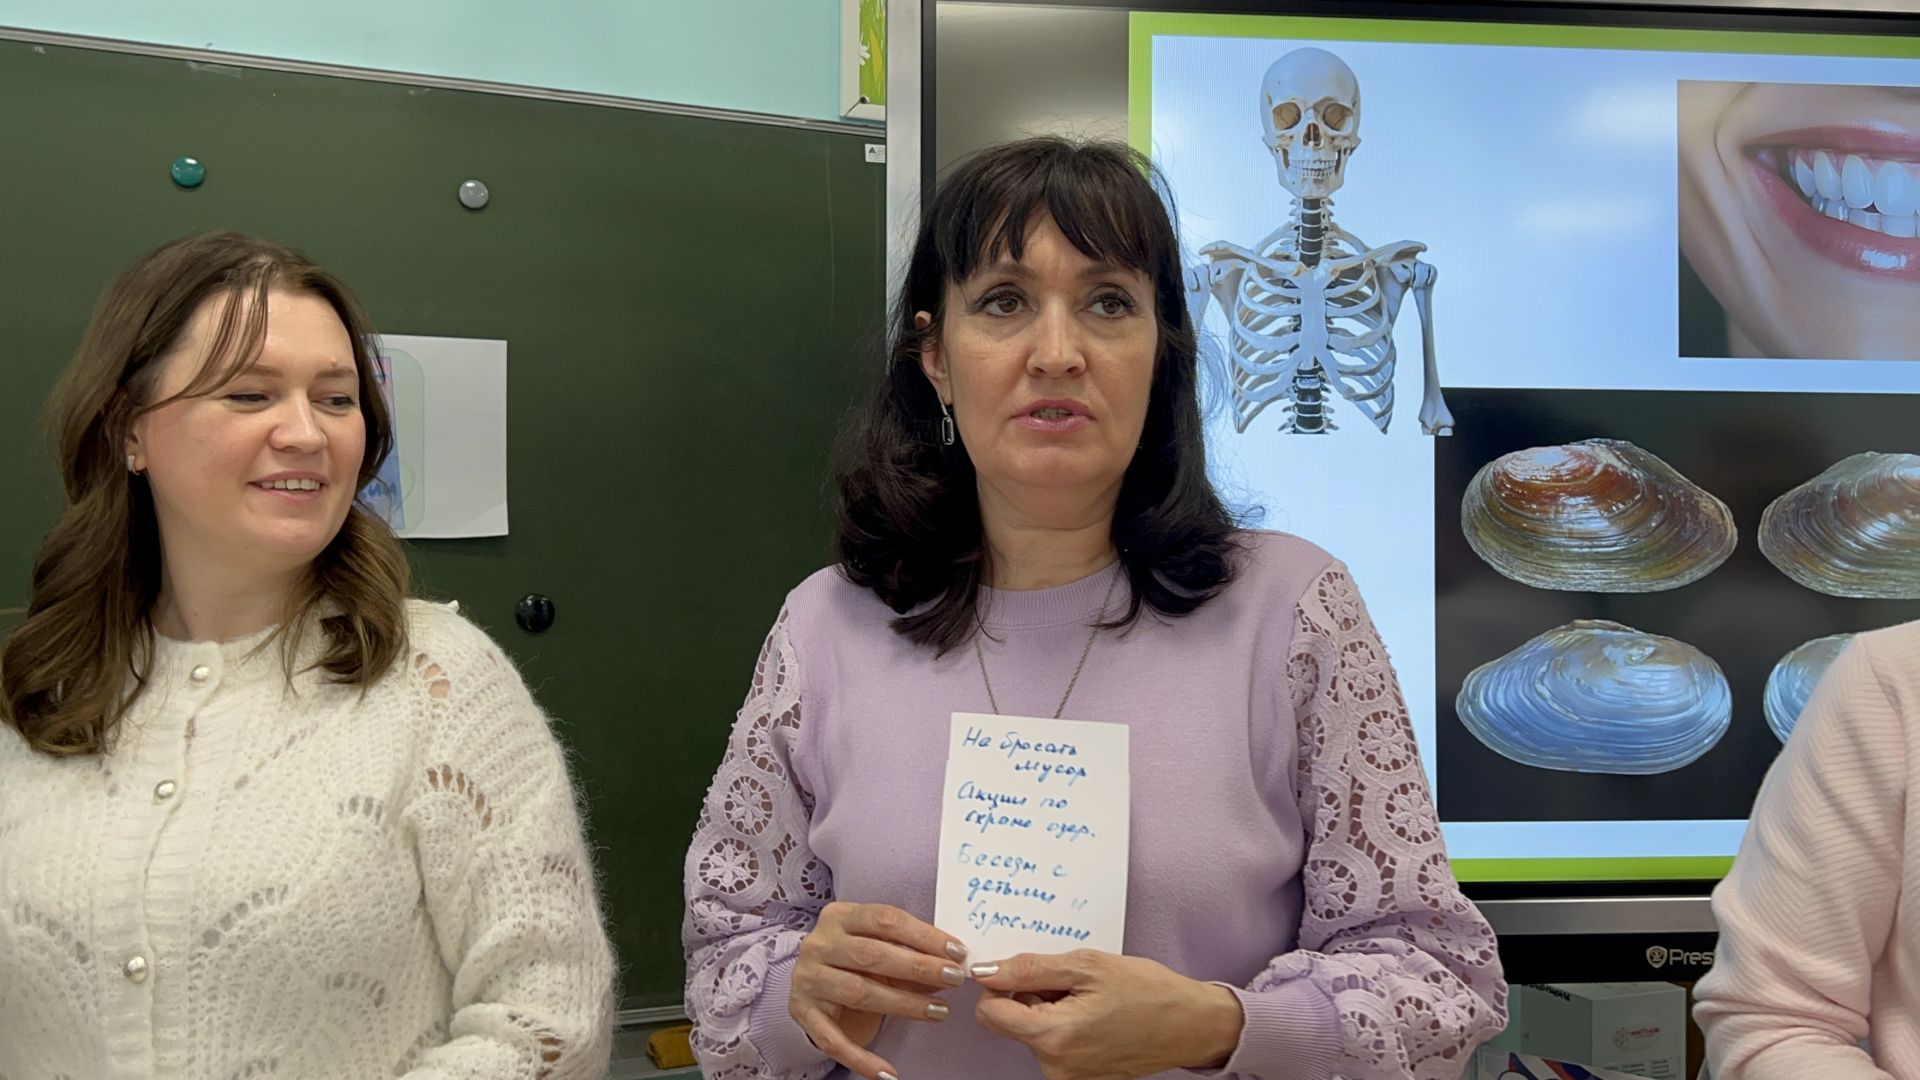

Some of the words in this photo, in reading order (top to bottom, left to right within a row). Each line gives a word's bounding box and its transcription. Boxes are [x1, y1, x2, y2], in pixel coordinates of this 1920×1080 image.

[962, 727, 992, 747] Не
[999, 732, 1078, 758] бросать
[1014, 760, 1088, 787] мусор
[957, 781, 1027, 809] Акции
[1039, 798, 1068, 809] по
[957, 843, 1037, 877] Беседы
[968, 877, 1056, 903] детьми
